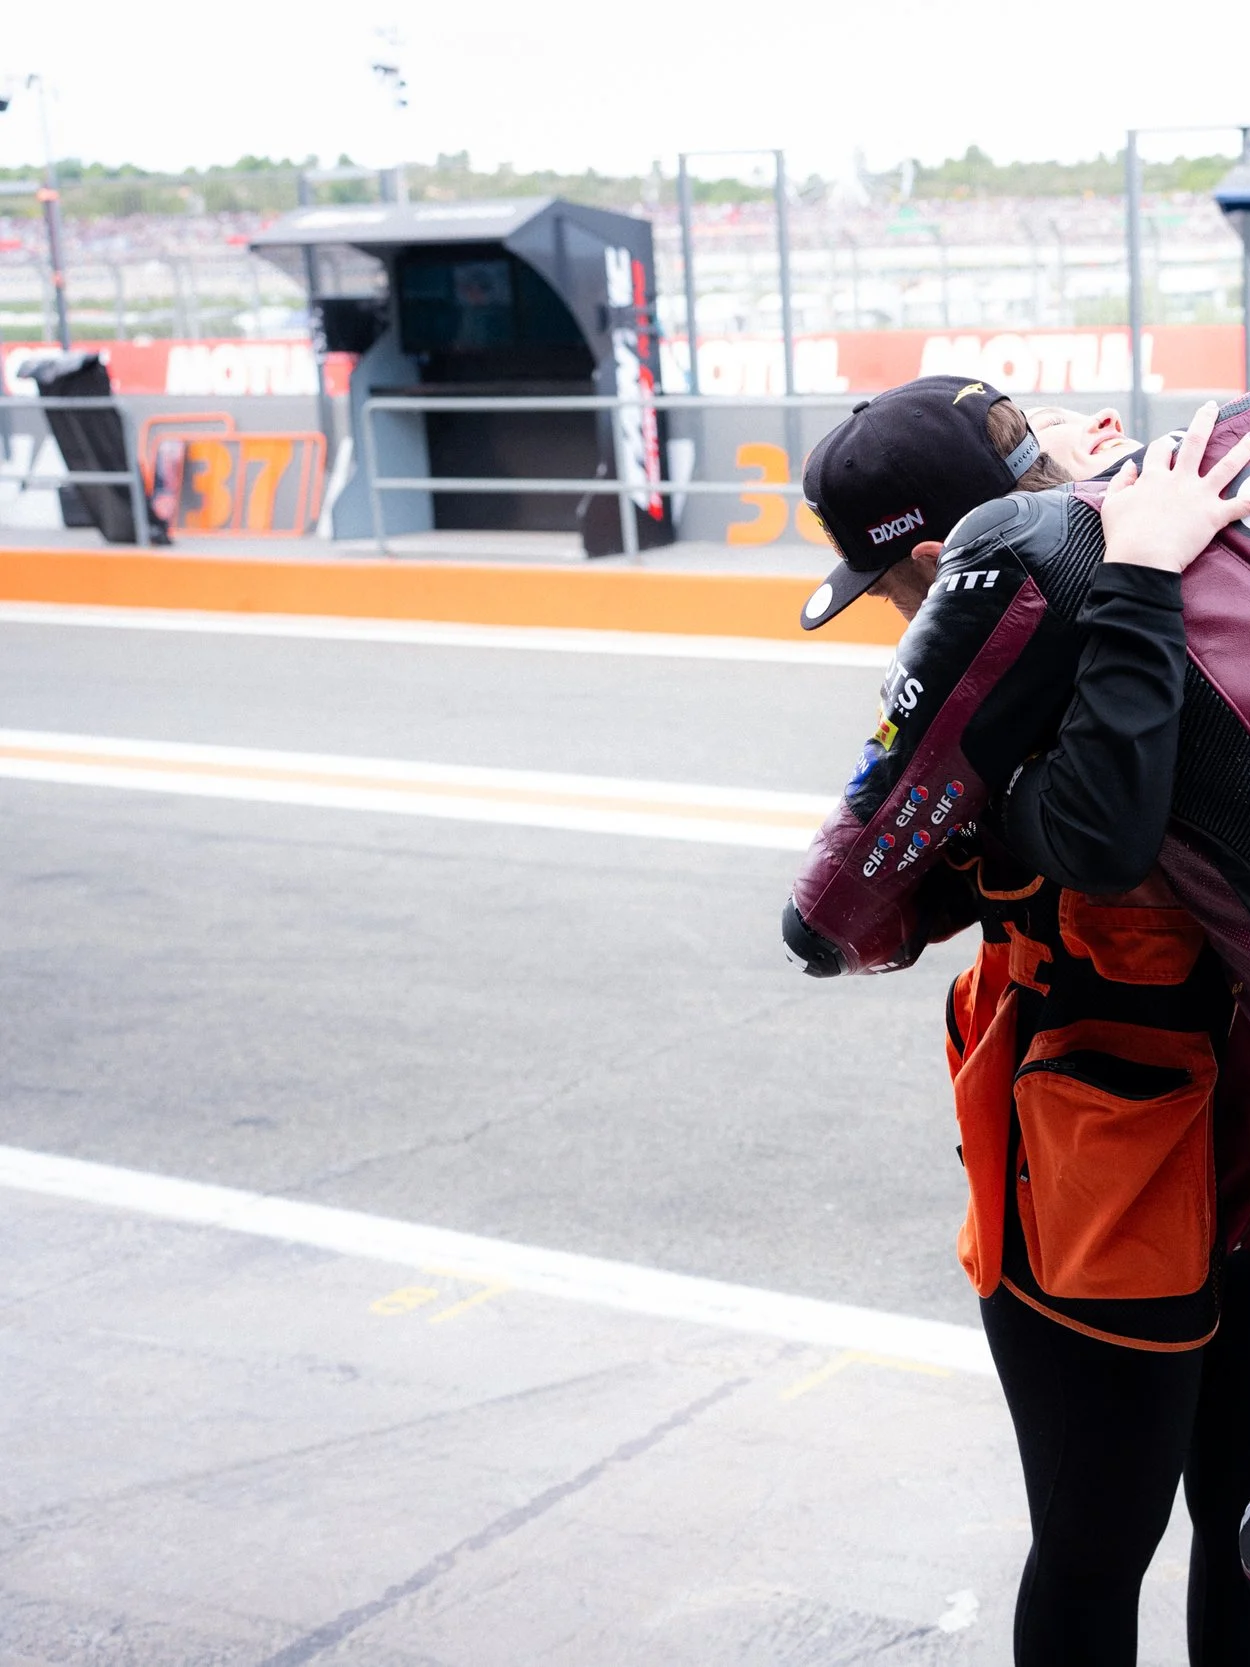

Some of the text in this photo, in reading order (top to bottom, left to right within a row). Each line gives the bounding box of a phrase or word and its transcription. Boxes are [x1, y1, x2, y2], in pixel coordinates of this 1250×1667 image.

[920, 334, 1163, 394] MOTUL
[867, 508, 924, 545] DIXON
[930, 794, 954, 825] elf
[862, 846, 886, 878] elf
